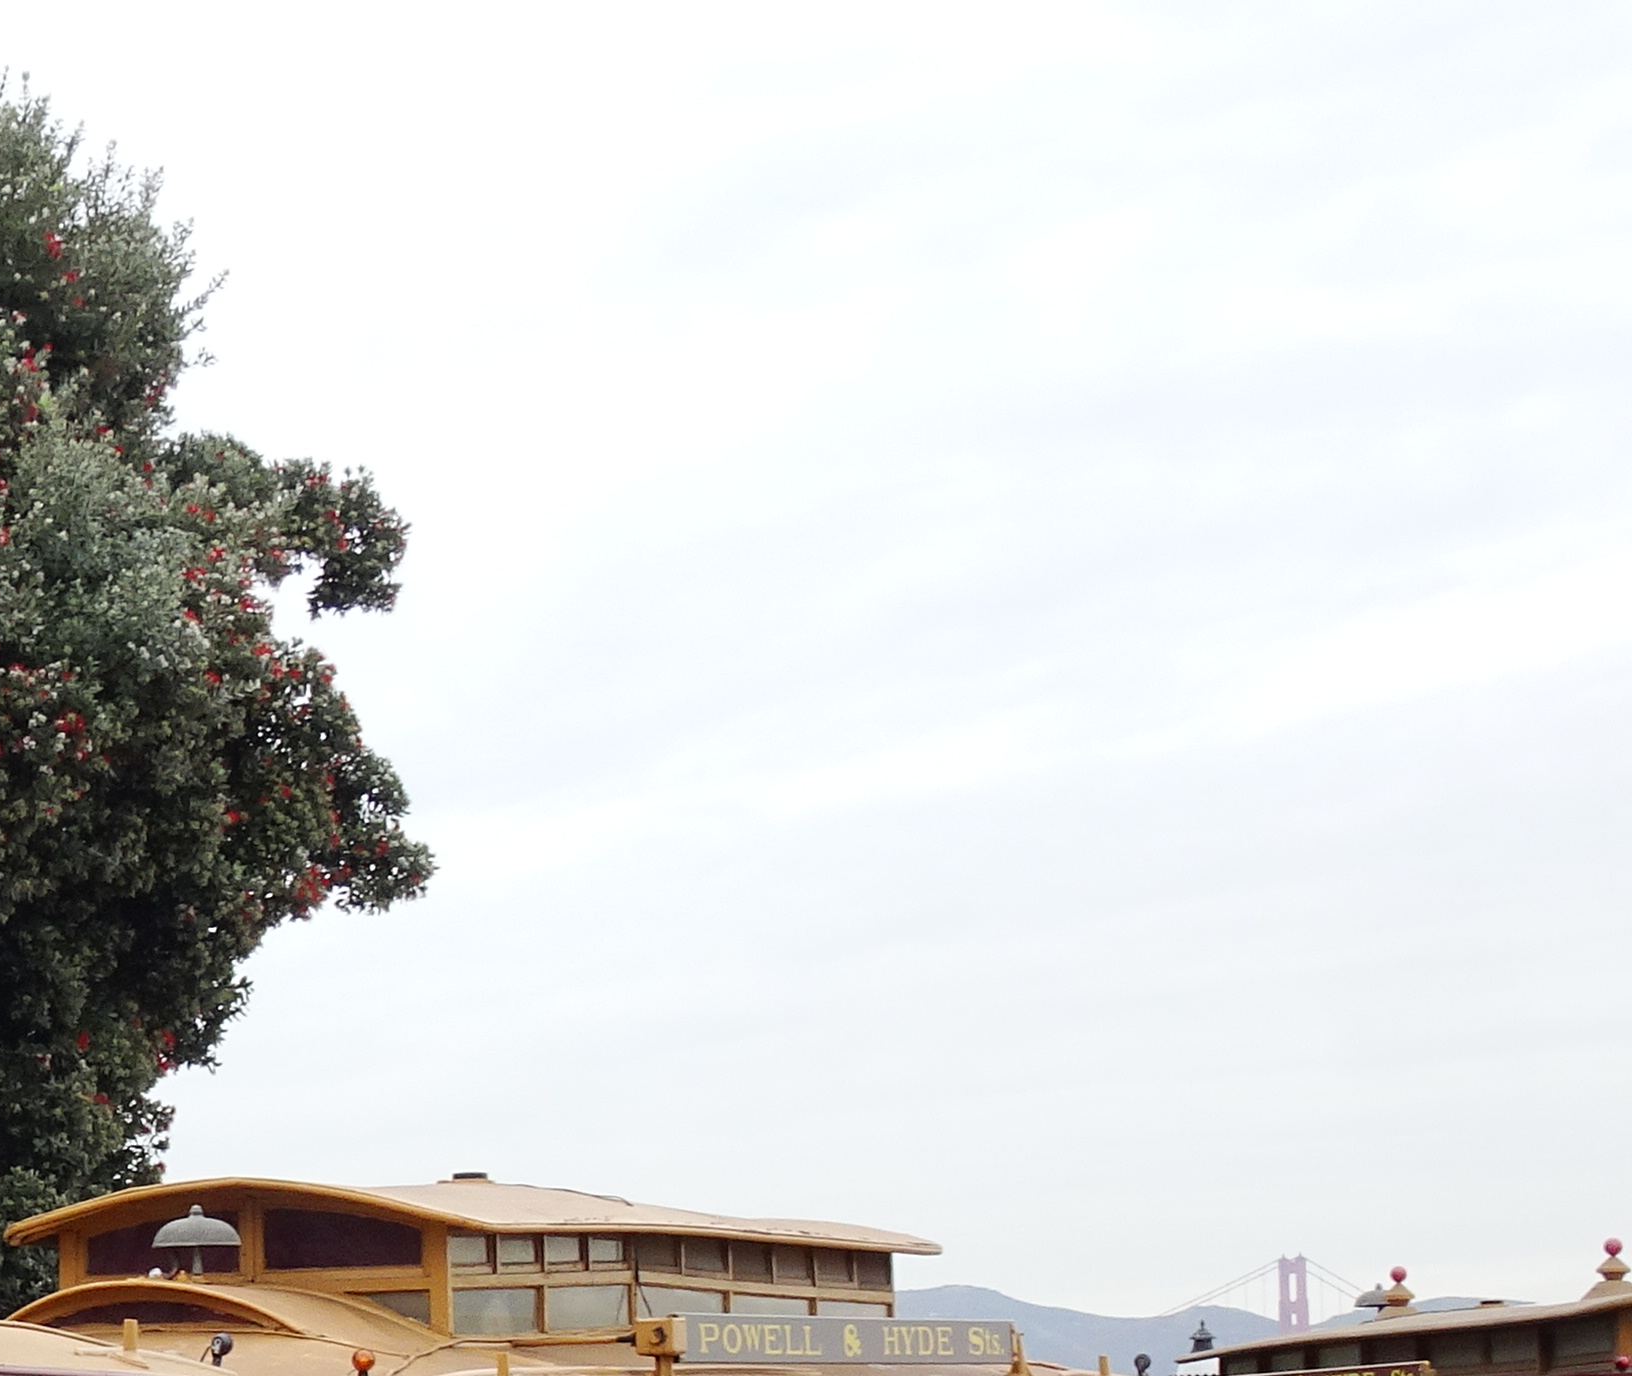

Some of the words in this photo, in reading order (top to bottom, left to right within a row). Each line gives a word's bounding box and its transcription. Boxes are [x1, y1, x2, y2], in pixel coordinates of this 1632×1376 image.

[698, 1323, 823, 1356] POWELL
[842, 1324, 863, 1357] &
[882, 1326, 954, 1357] HYDE
